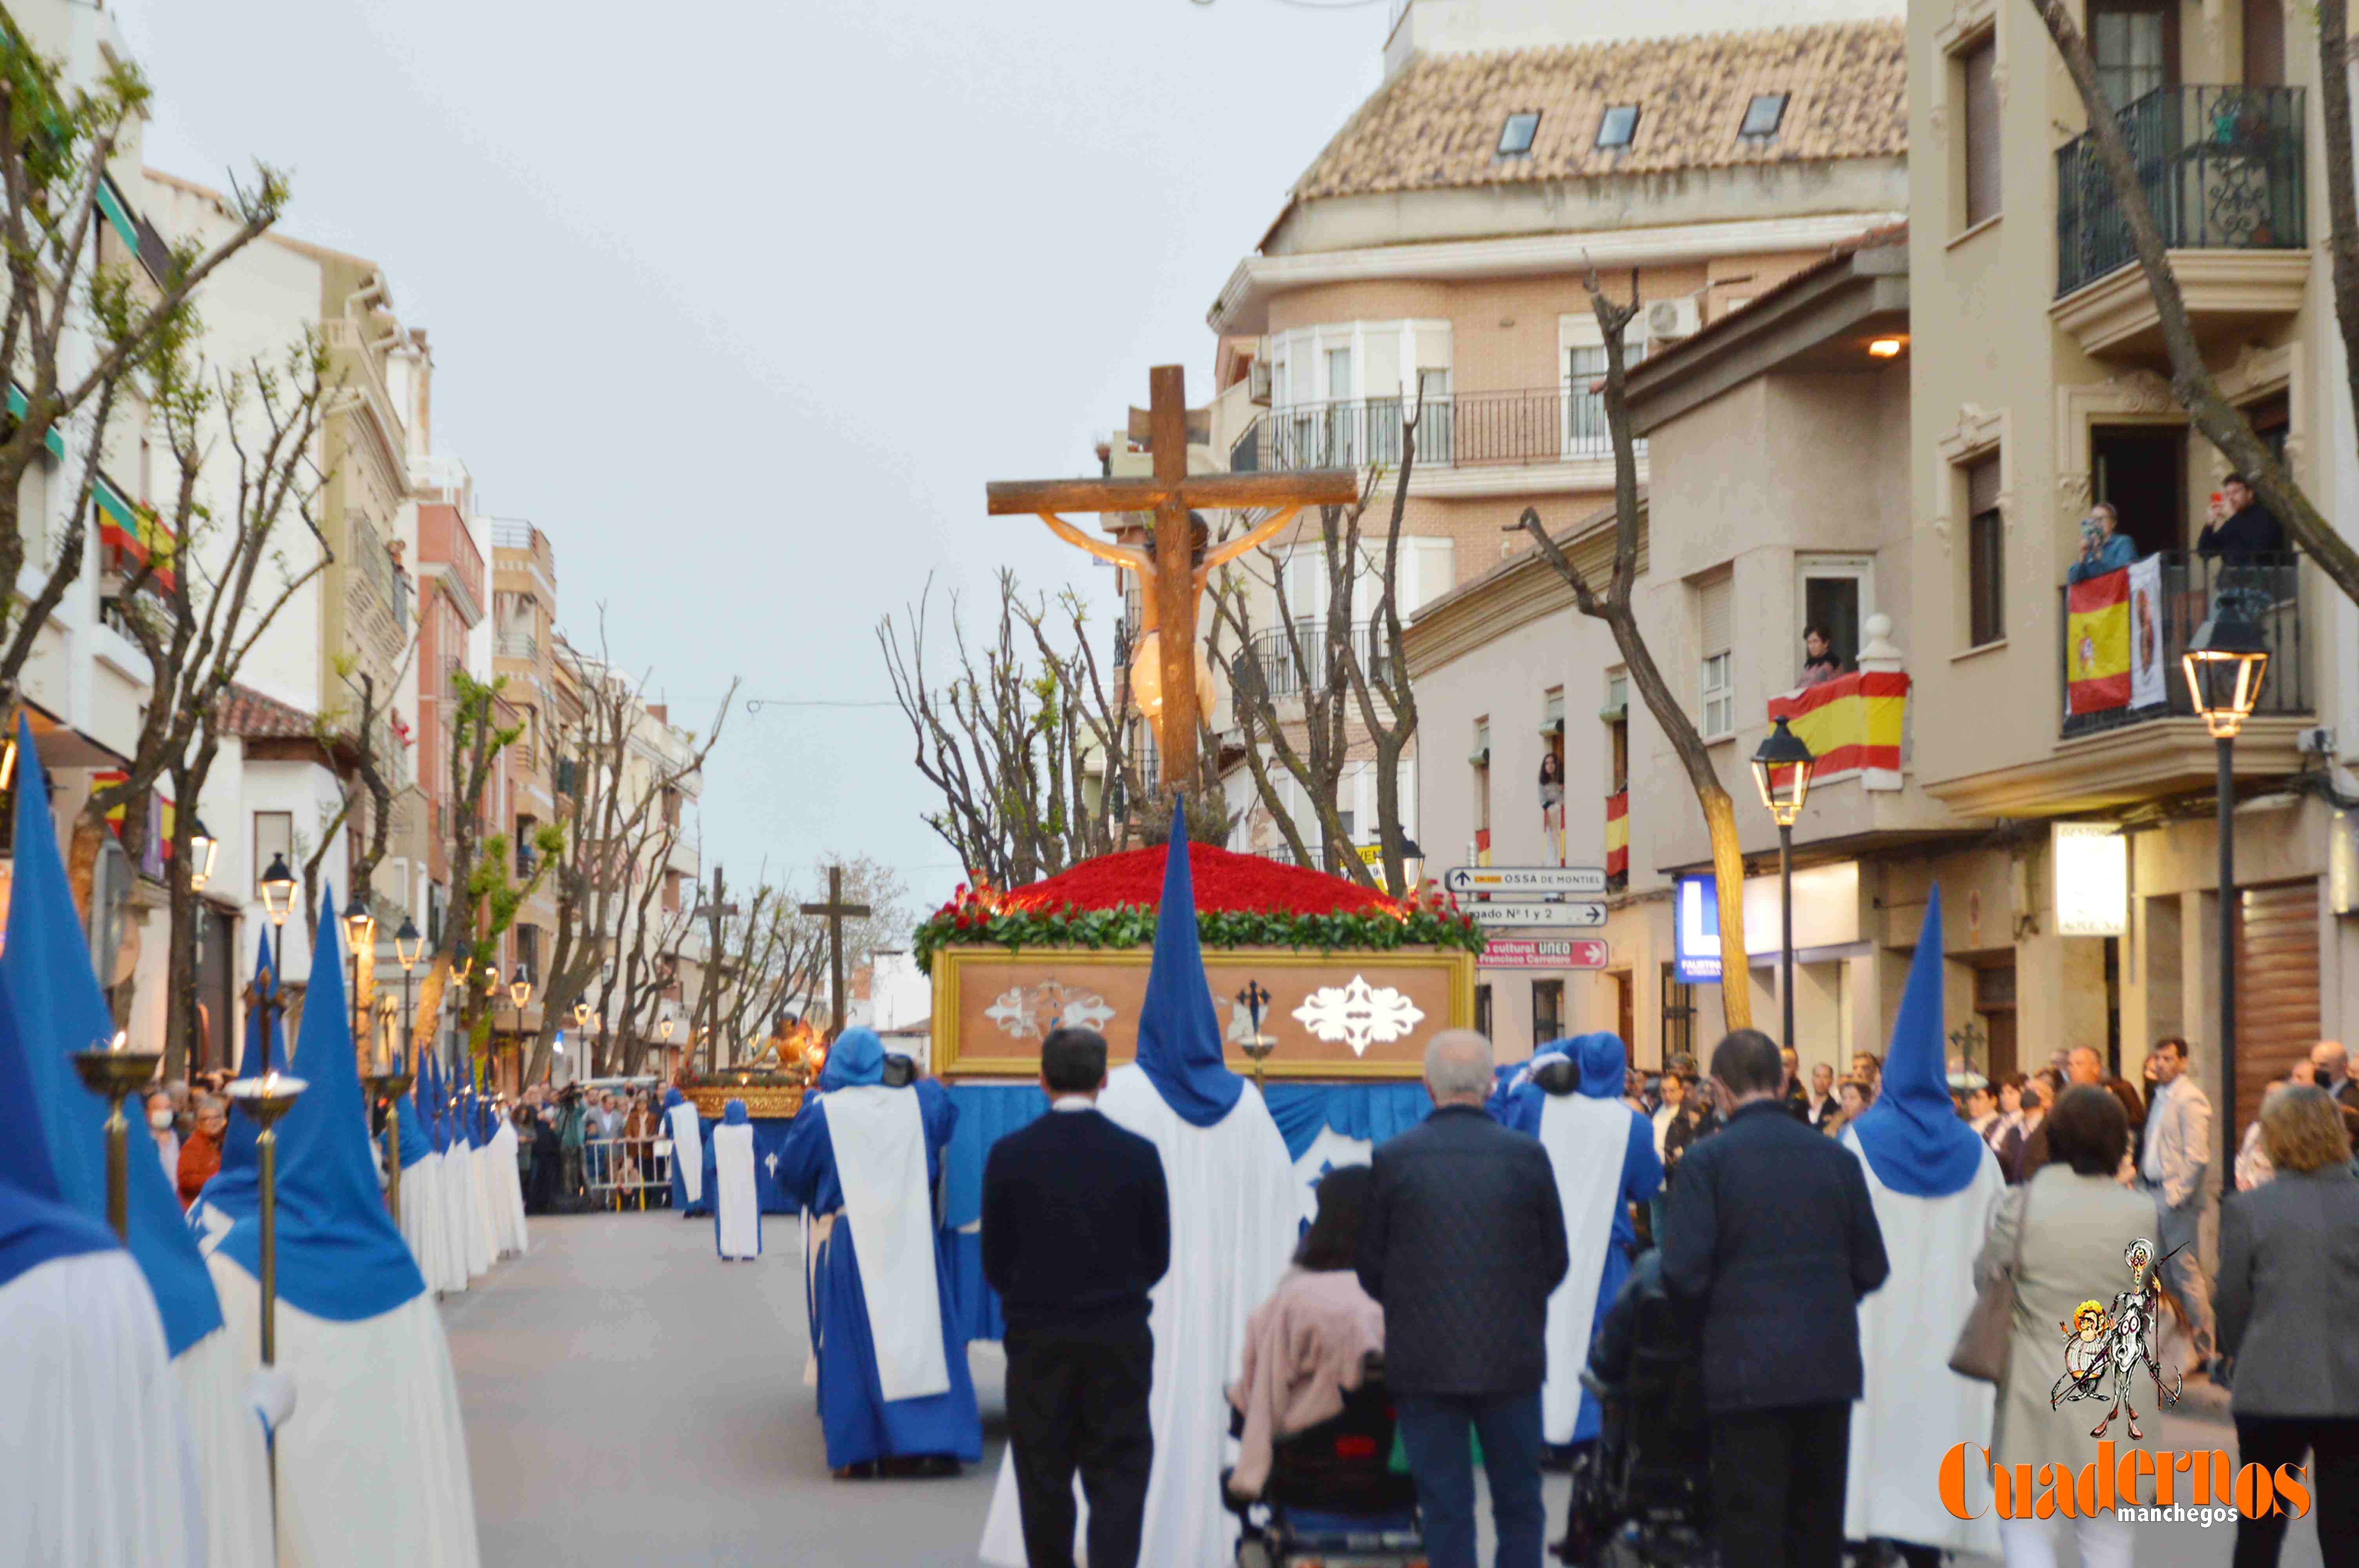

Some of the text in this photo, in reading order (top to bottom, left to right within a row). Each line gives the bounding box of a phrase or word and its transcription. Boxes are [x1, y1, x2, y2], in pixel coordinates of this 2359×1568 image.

[1505, 874, 1537, 883] OSSA
[1525, 909, 1528, 918] 1
[1534, 911, 1540, 920] y
[1545, 909, 1552, 918] 2
[1493, 942, 1535, 953] cultural
[1480, 953, 1570, 964] Francisco Carretero
